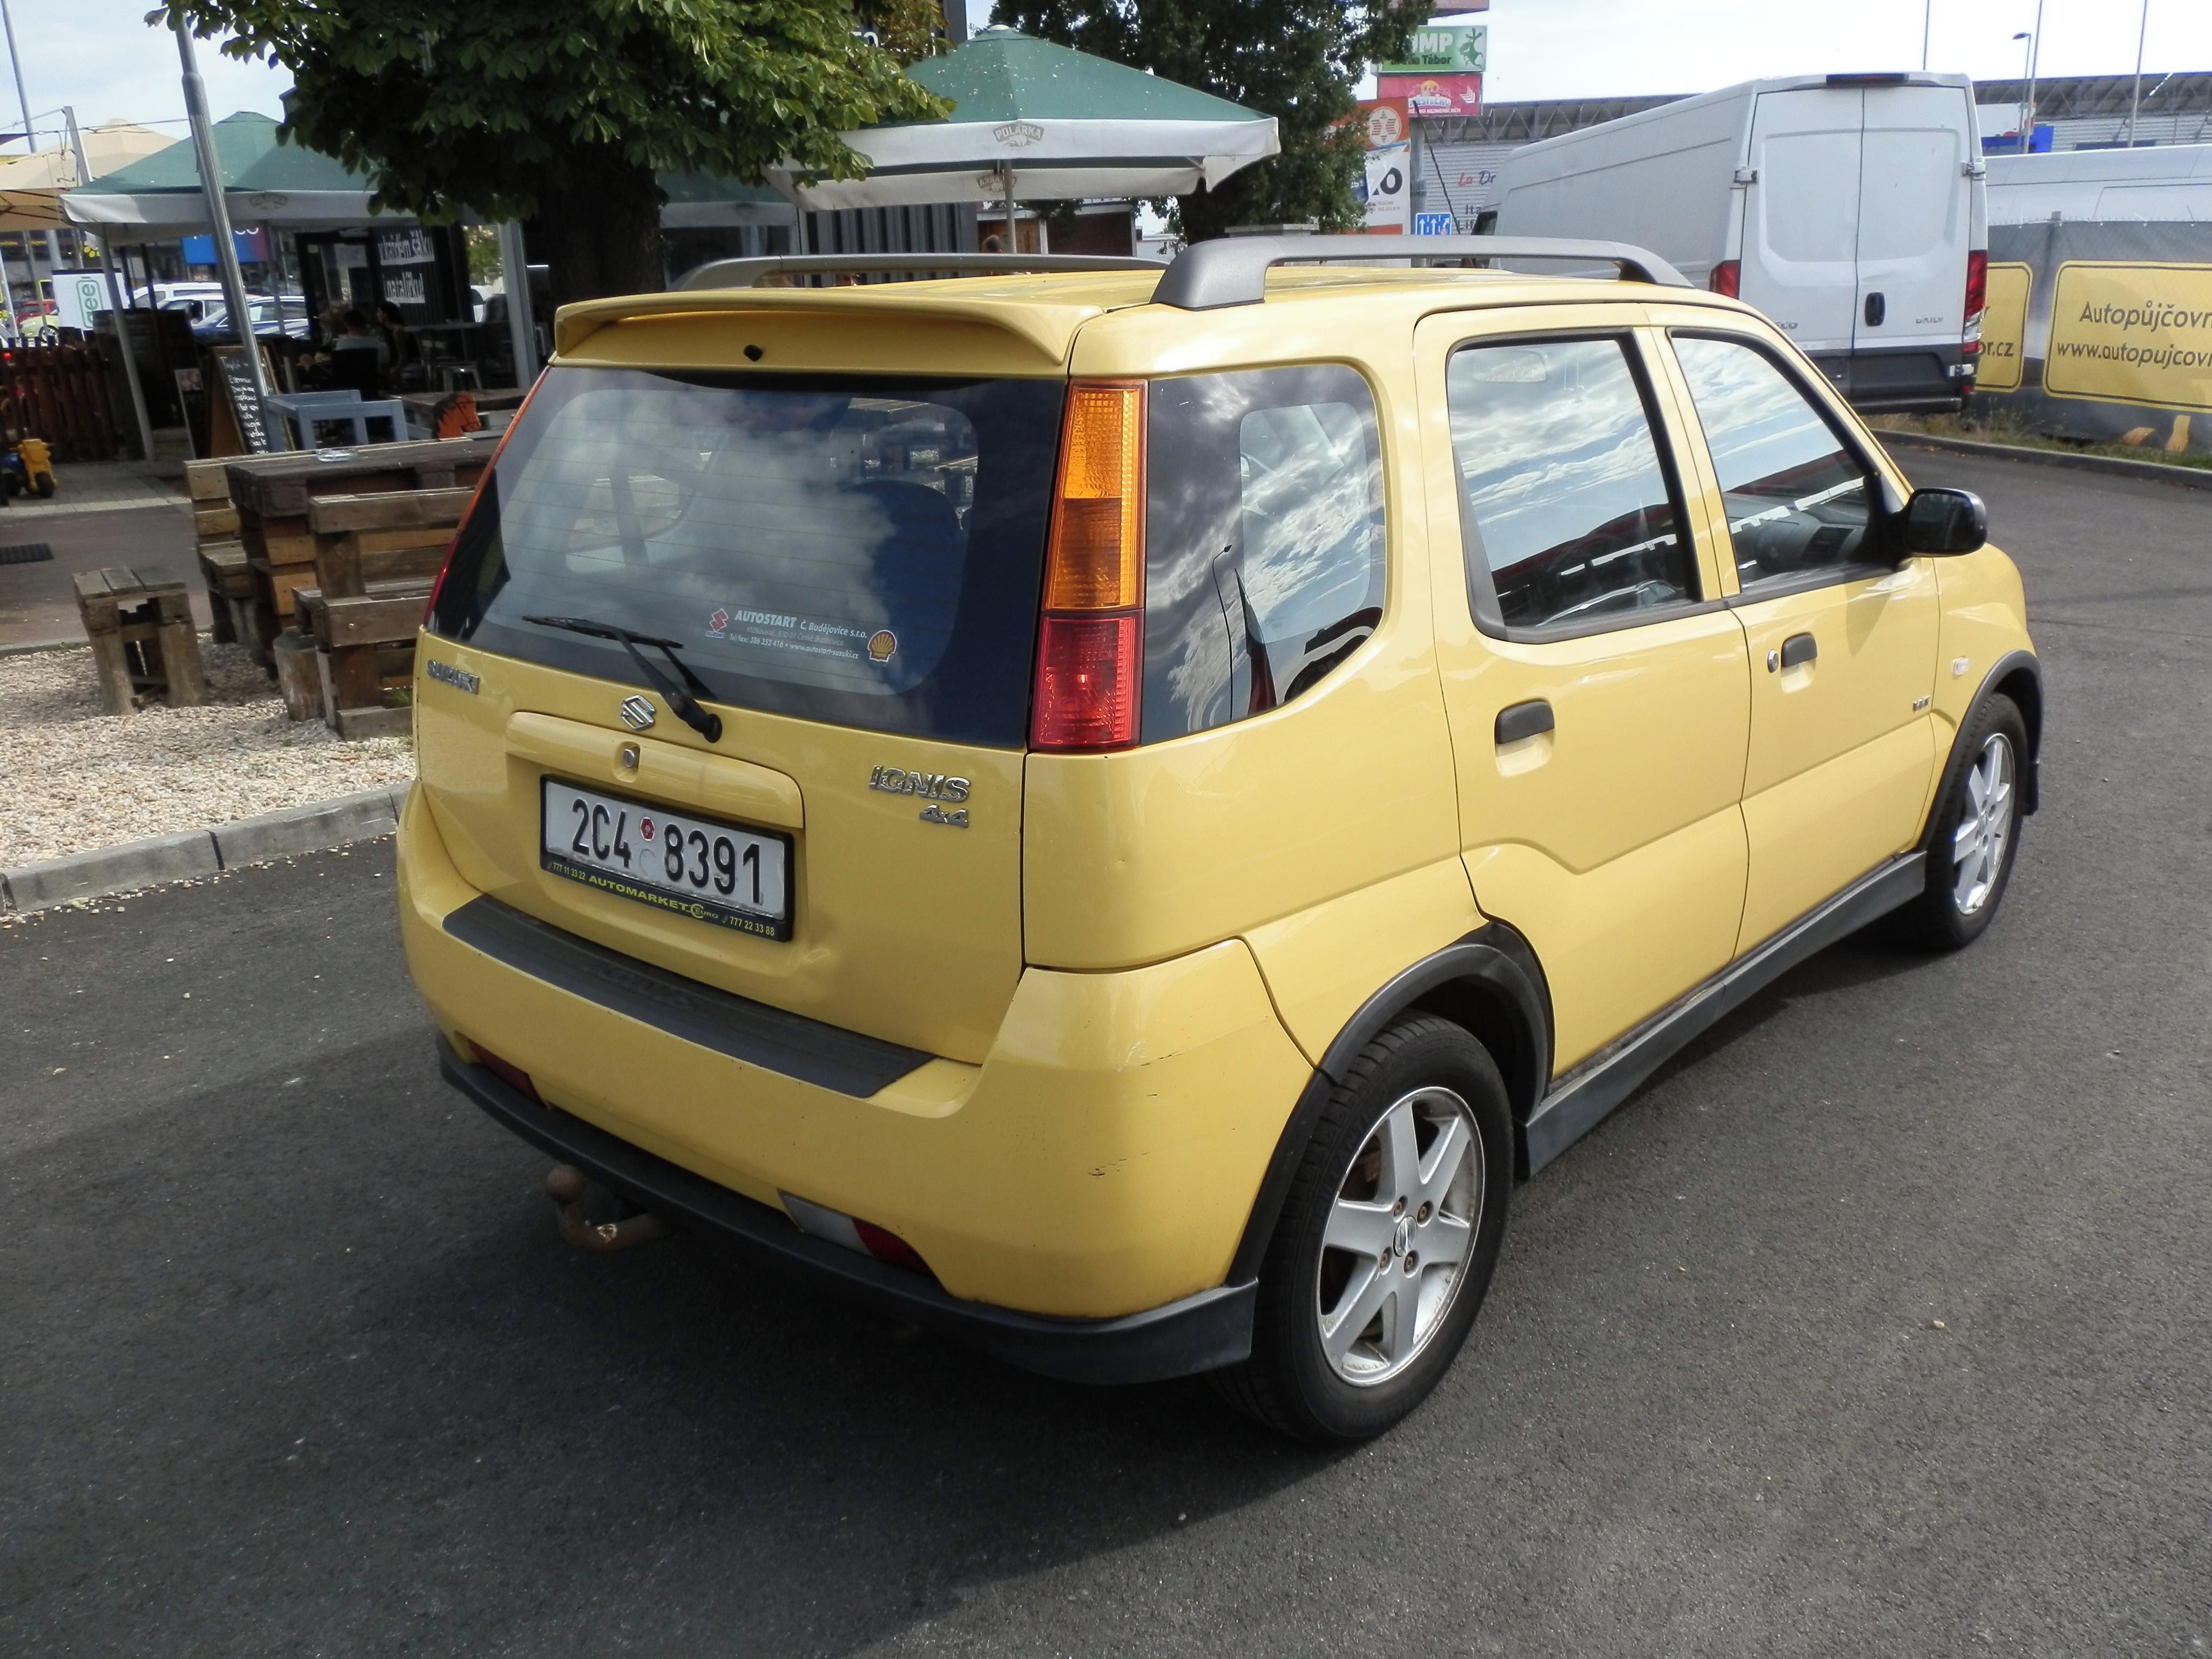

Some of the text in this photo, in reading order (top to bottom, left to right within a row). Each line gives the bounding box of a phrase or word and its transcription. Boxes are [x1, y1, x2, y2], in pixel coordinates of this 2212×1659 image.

[1422, 53, 1452, 65] Tábor
[734, 610, 797, 628] AUTOSTART
[808, 622, 848, 636] Budějovice
[849, 629, 867, 639] s.r.o.
[761, 638, 772, 646] 352
[773, 639, 784, 648] 416
[790, 644, 859, 659] www.autostart-suzuki.cz
[427, 659, 480, 696] SUZUKI
[869, 765, 972, 803] IGNIS
[919, 803, 969, 828] 4x4
[572, 798, 761, 904] 2C4 8391
[553, 862, 562, 872] 777
[564, 866, 570, 875] 11
[570, 868, 578, 878] 33
[578, 870, 586, 880] 22
[589, 875, 688, 911] AUTOMARKET
[730, 916, 743, 927] 777
[744, 920, 753, 930] 22
[754, 922, 764, 933] 33
[765, 926, 775, 936] 88
